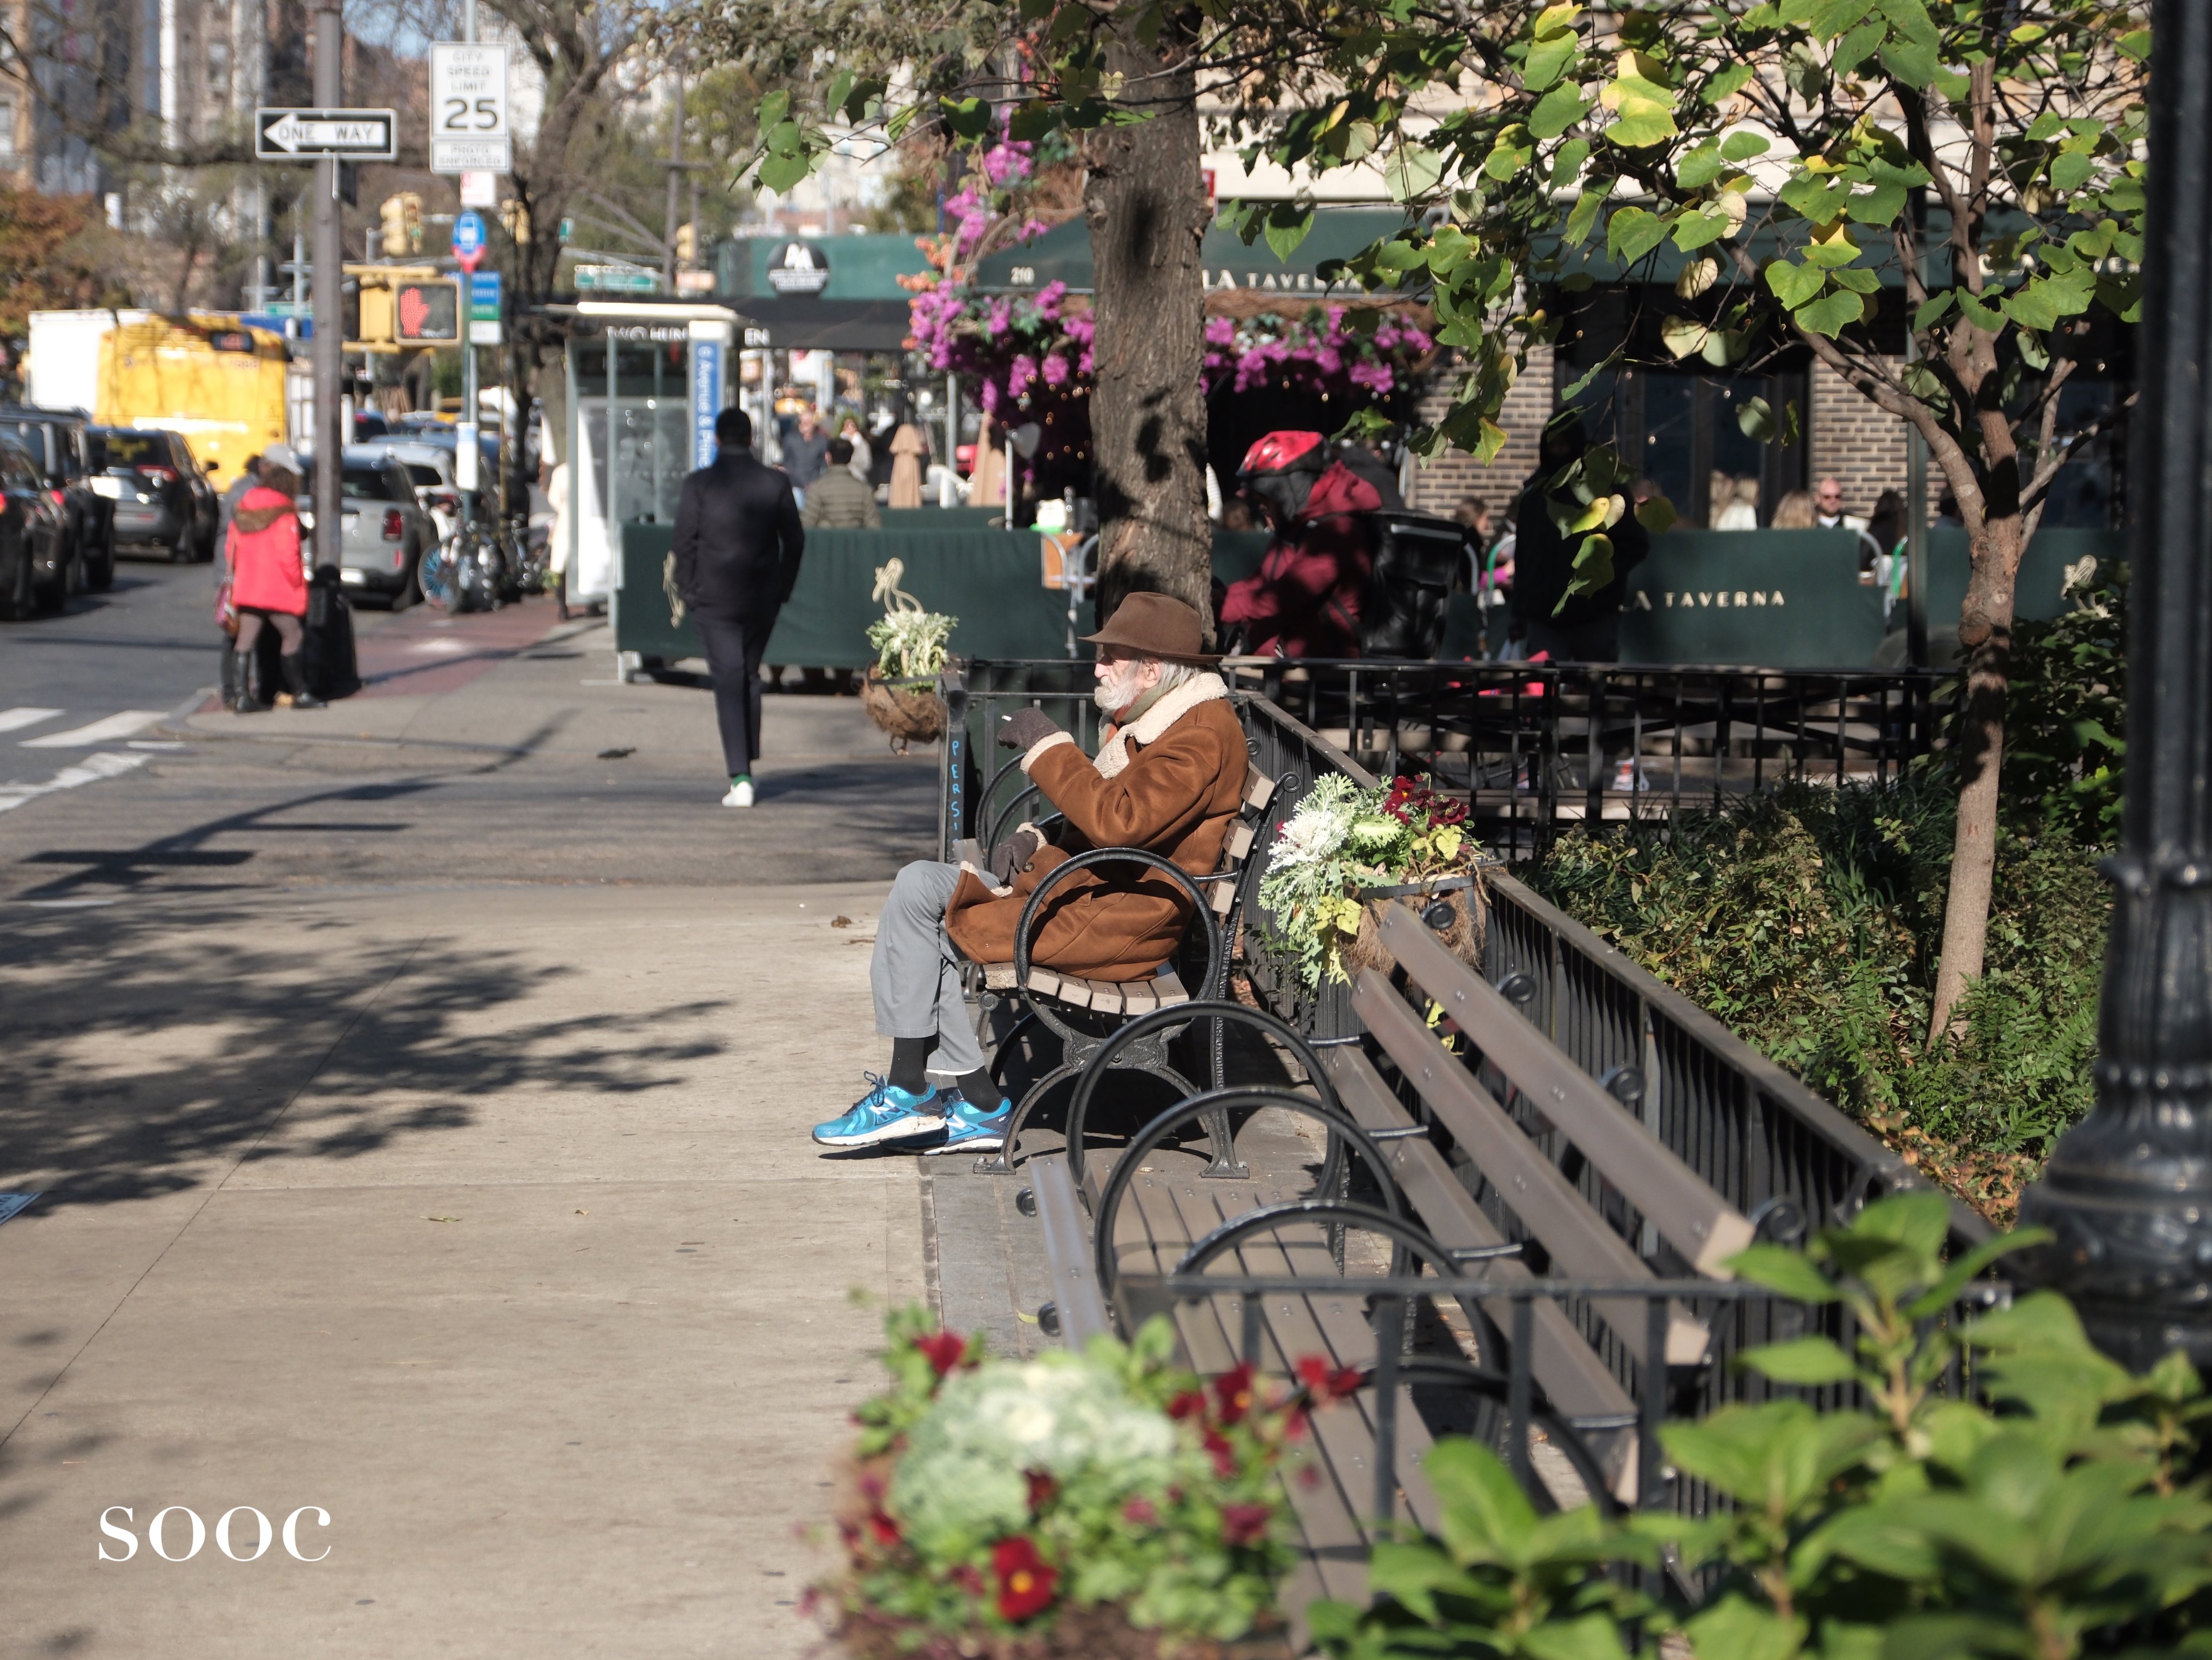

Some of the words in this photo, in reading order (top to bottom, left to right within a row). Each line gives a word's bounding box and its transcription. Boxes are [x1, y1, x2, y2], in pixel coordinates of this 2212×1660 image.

[446, 64, 492, 78] SPEED
[450, 80, 487, 93] LIMIT
[444, 96, 498, 130] 25
[279, 123, 315, 144] ONE
[334, 123, 374, 144] WAY
[1010, 266, 1035, 285] 210
[1664, 590, 1785, 608] TAVERNA
[951, 740, 961, 842] PERSI
